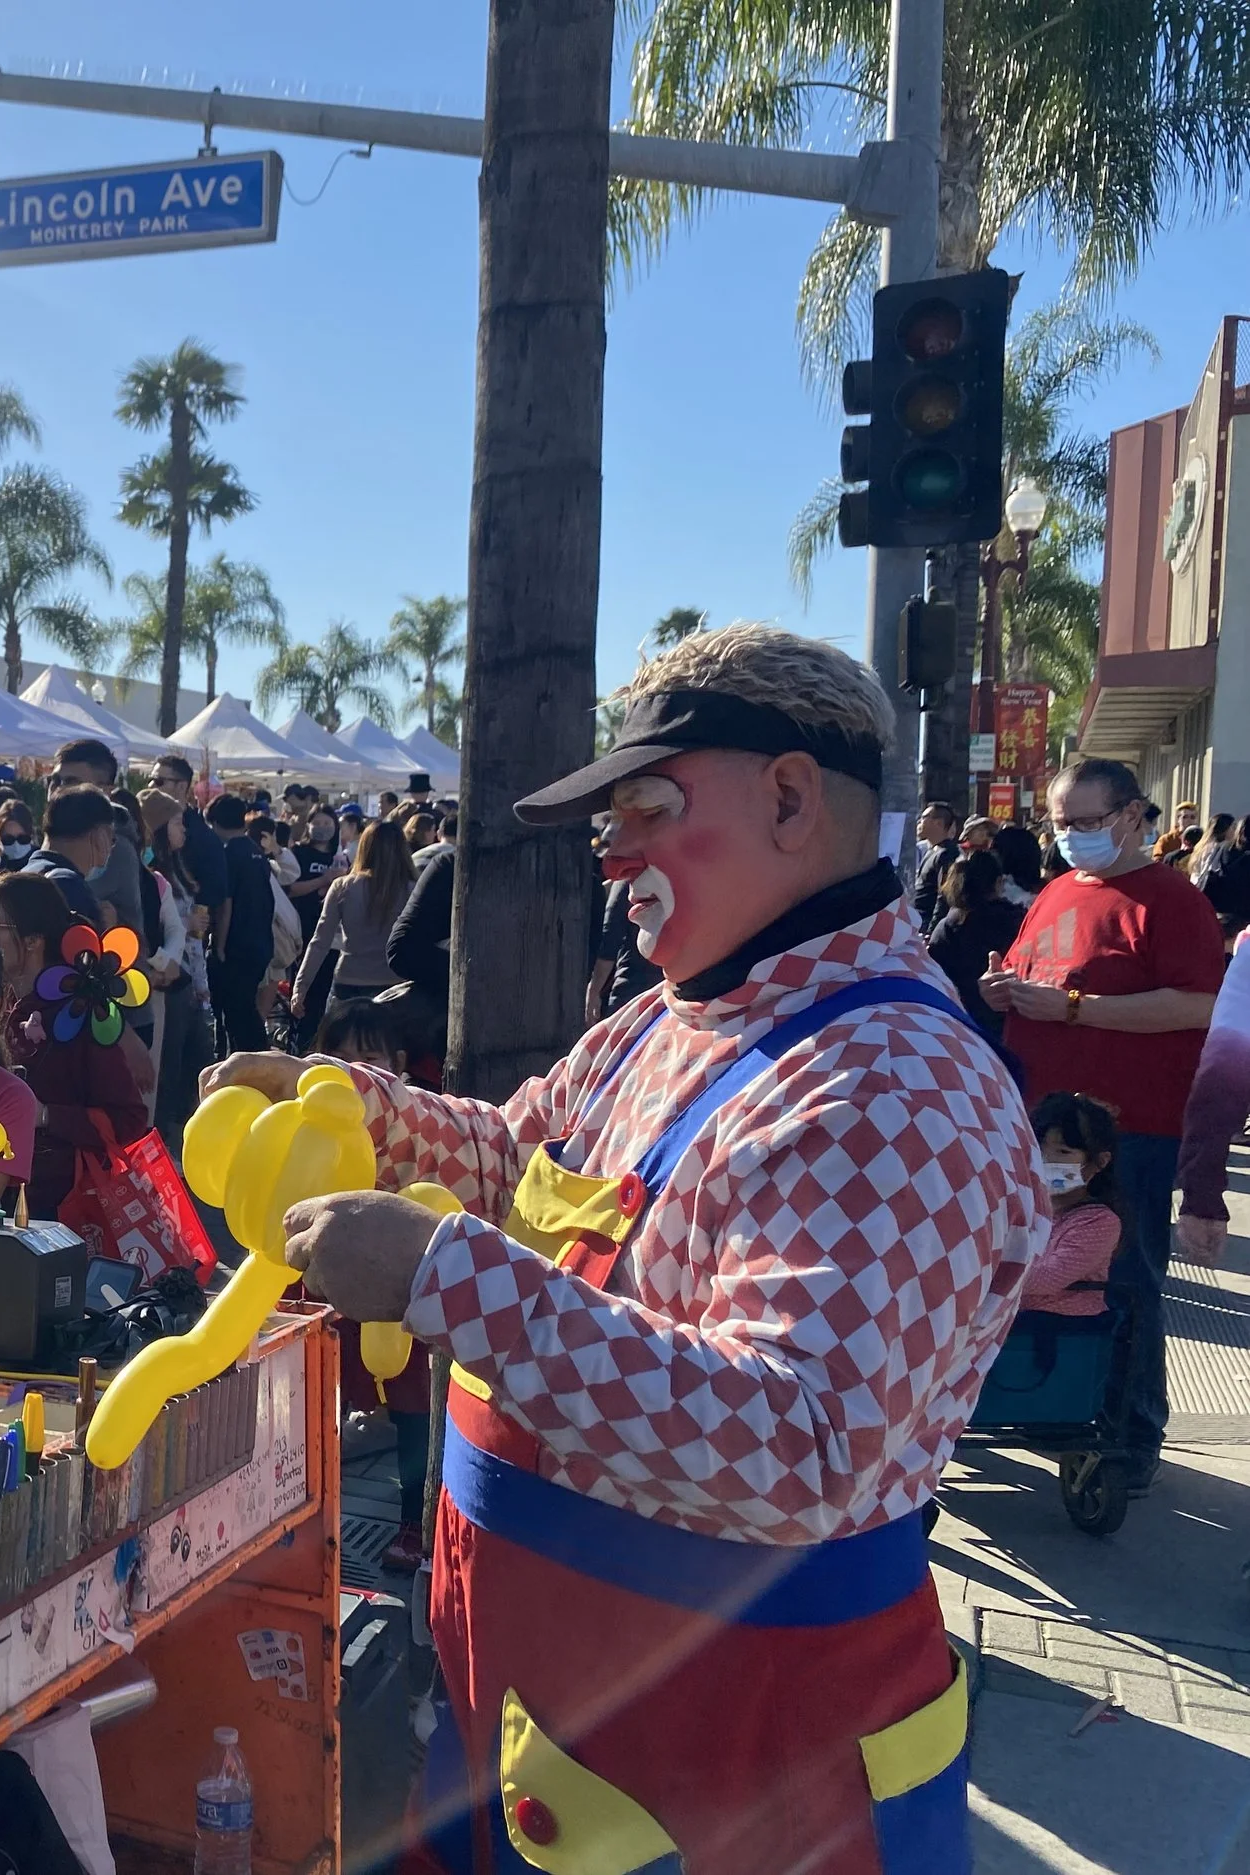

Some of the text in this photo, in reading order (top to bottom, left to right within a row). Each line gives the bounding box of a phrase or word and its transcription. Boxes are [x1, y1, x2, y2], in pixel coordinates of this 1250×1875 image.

[160, 172, 244, 211] Ave
[30, 214, 189, 245] MONTEREY PARK
[1007, 687, 1037, 699] Happy
